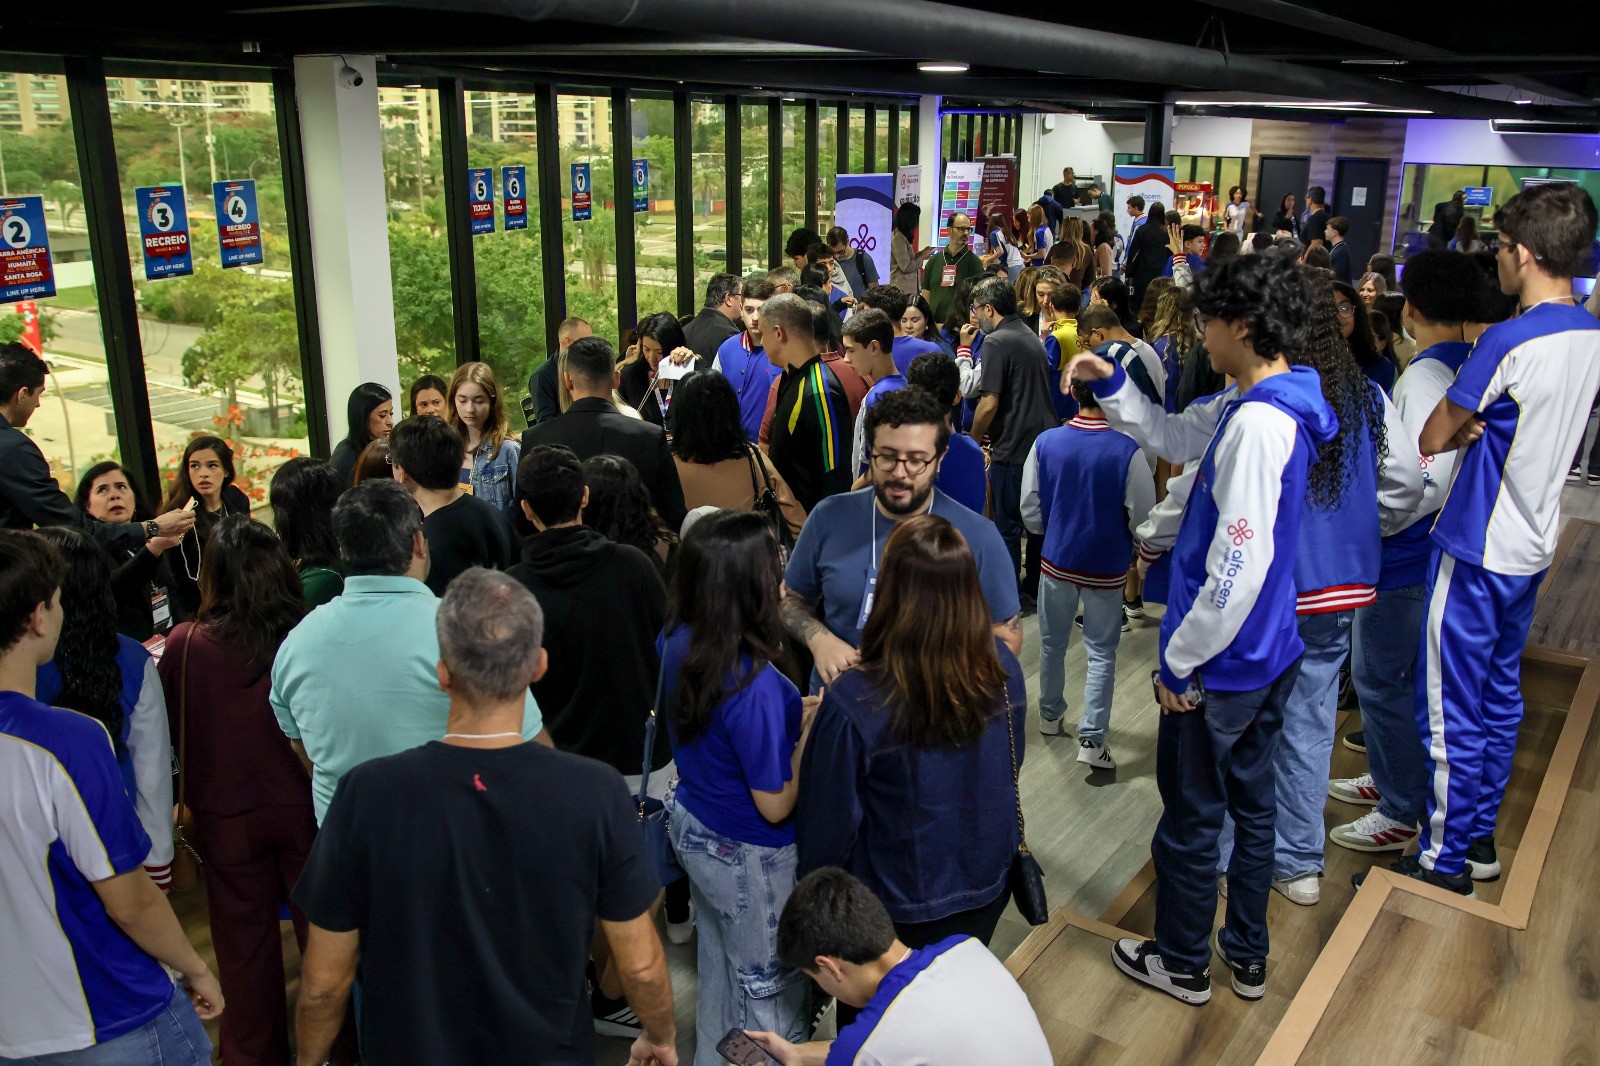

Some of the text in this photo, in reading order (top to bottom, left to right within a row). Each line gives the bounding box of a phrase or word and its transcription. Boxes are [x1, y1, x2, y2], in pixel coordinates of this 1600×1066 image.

[578, 175, 583, 188] 7
[638, 171, 643, 182] 8
[478, 183, 484, 197] 5
[511, 181, 518, 194] 6
[231, 200, 244, 217] 4
[473, 204, 491, 212] TIJUCA
[156, 208, 170, 228] 3
[8, 221, 26, 243] 2
[226, 223, 252, 232] RECREIO
[145, 234, 187, 248] RECREIO
[0, 247, 46, 257] ARRA AMÉRICAS
[8, 259, 37, 268] HUMAITÁ
[4, 273, 25, 281] SANTA
